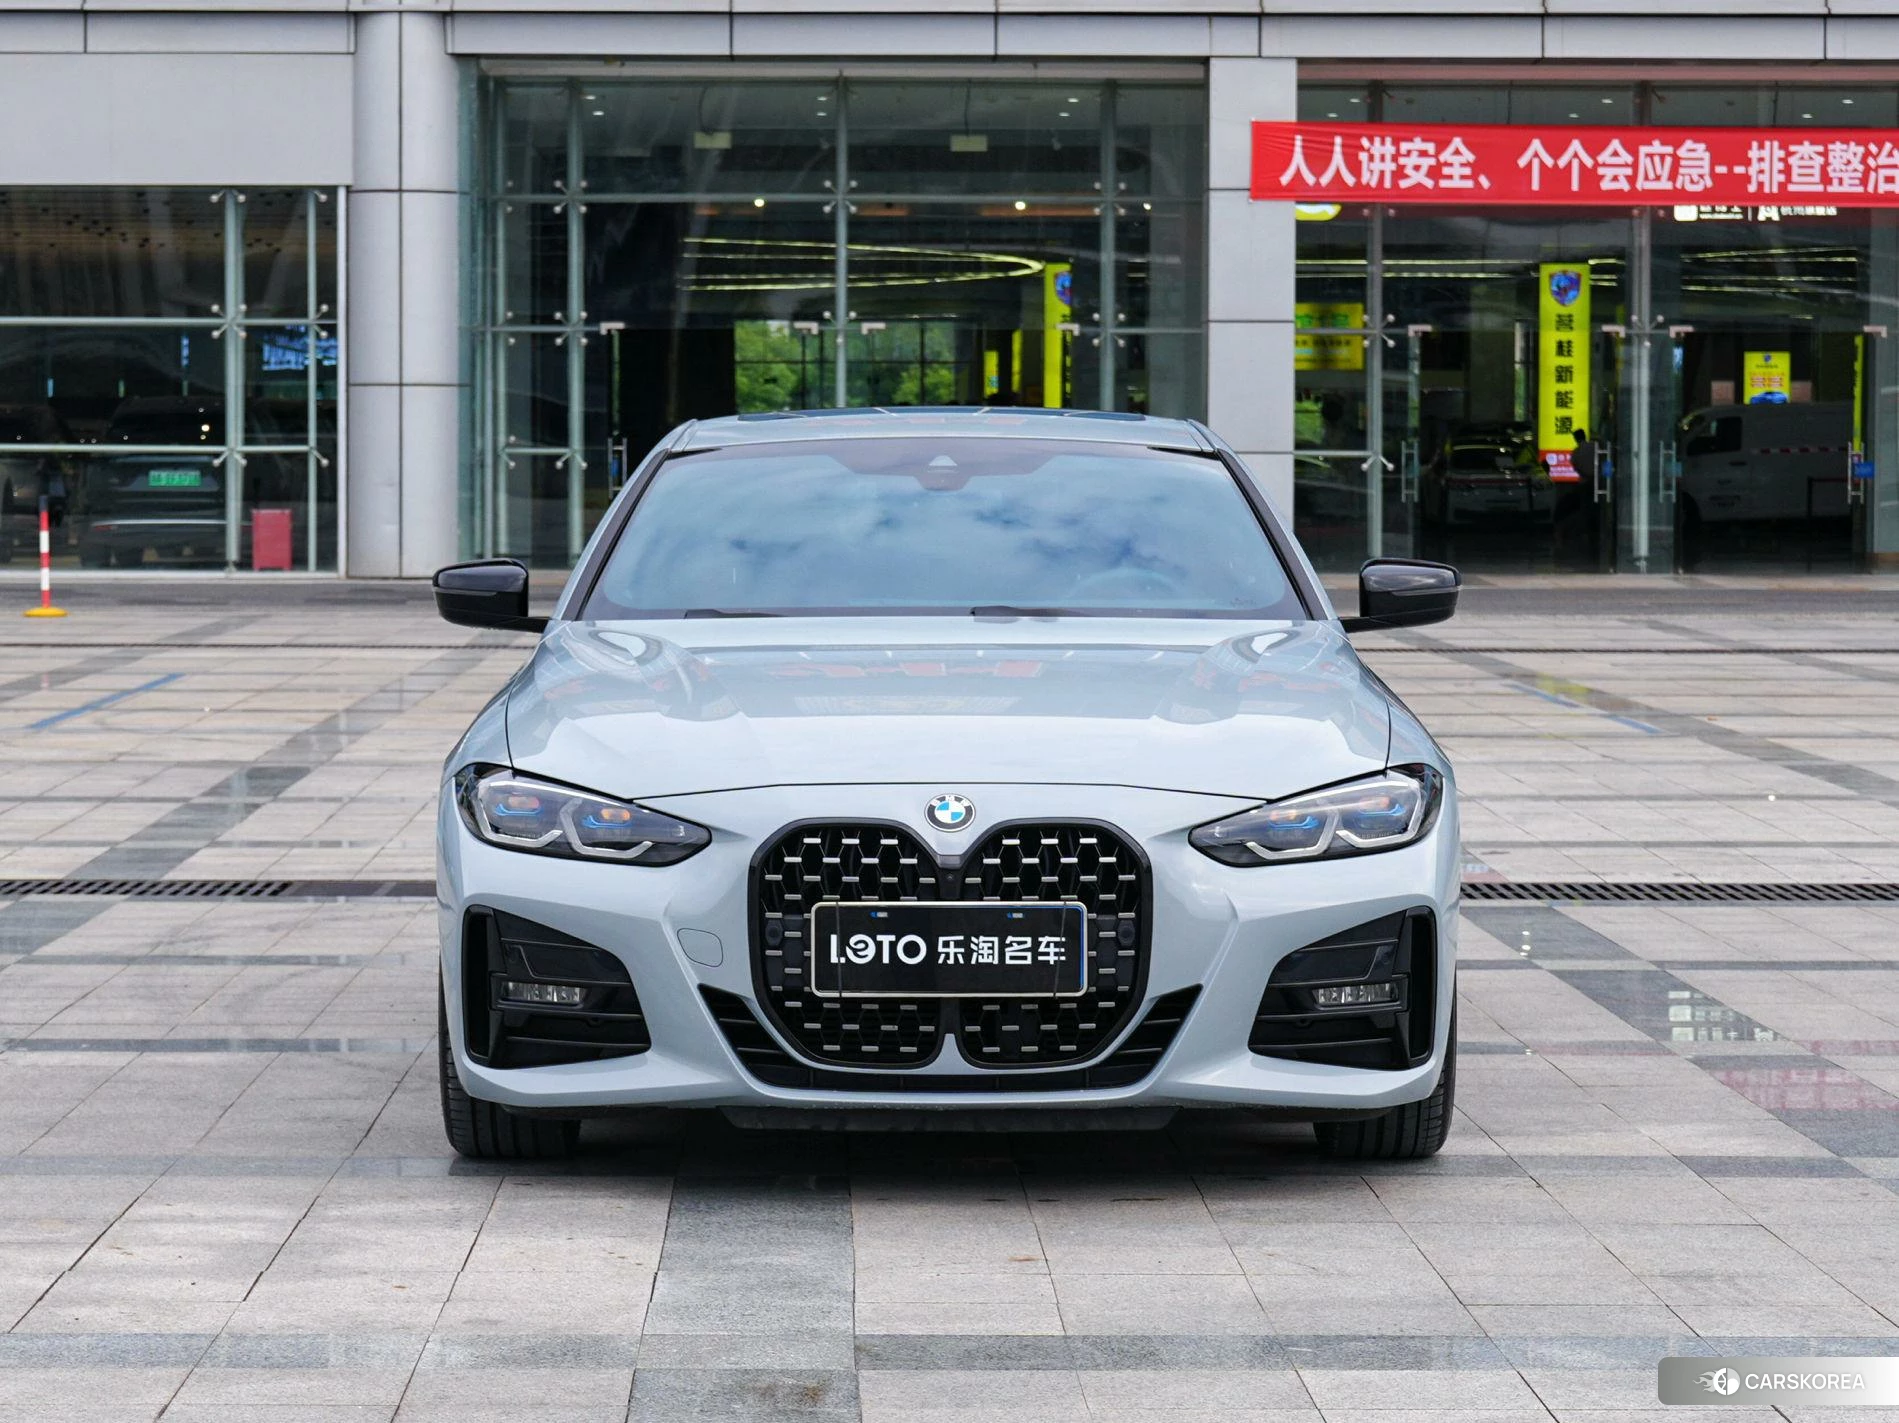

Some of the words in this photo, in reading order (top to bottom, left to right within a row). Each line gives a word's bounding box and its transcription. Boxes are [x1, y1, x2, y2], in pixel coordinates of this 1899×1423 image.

[930, 795, 971, 807] BMW
[830, 934, 927, 965] LOTO
[937, 935, 1067, 965] 乐淘名车
